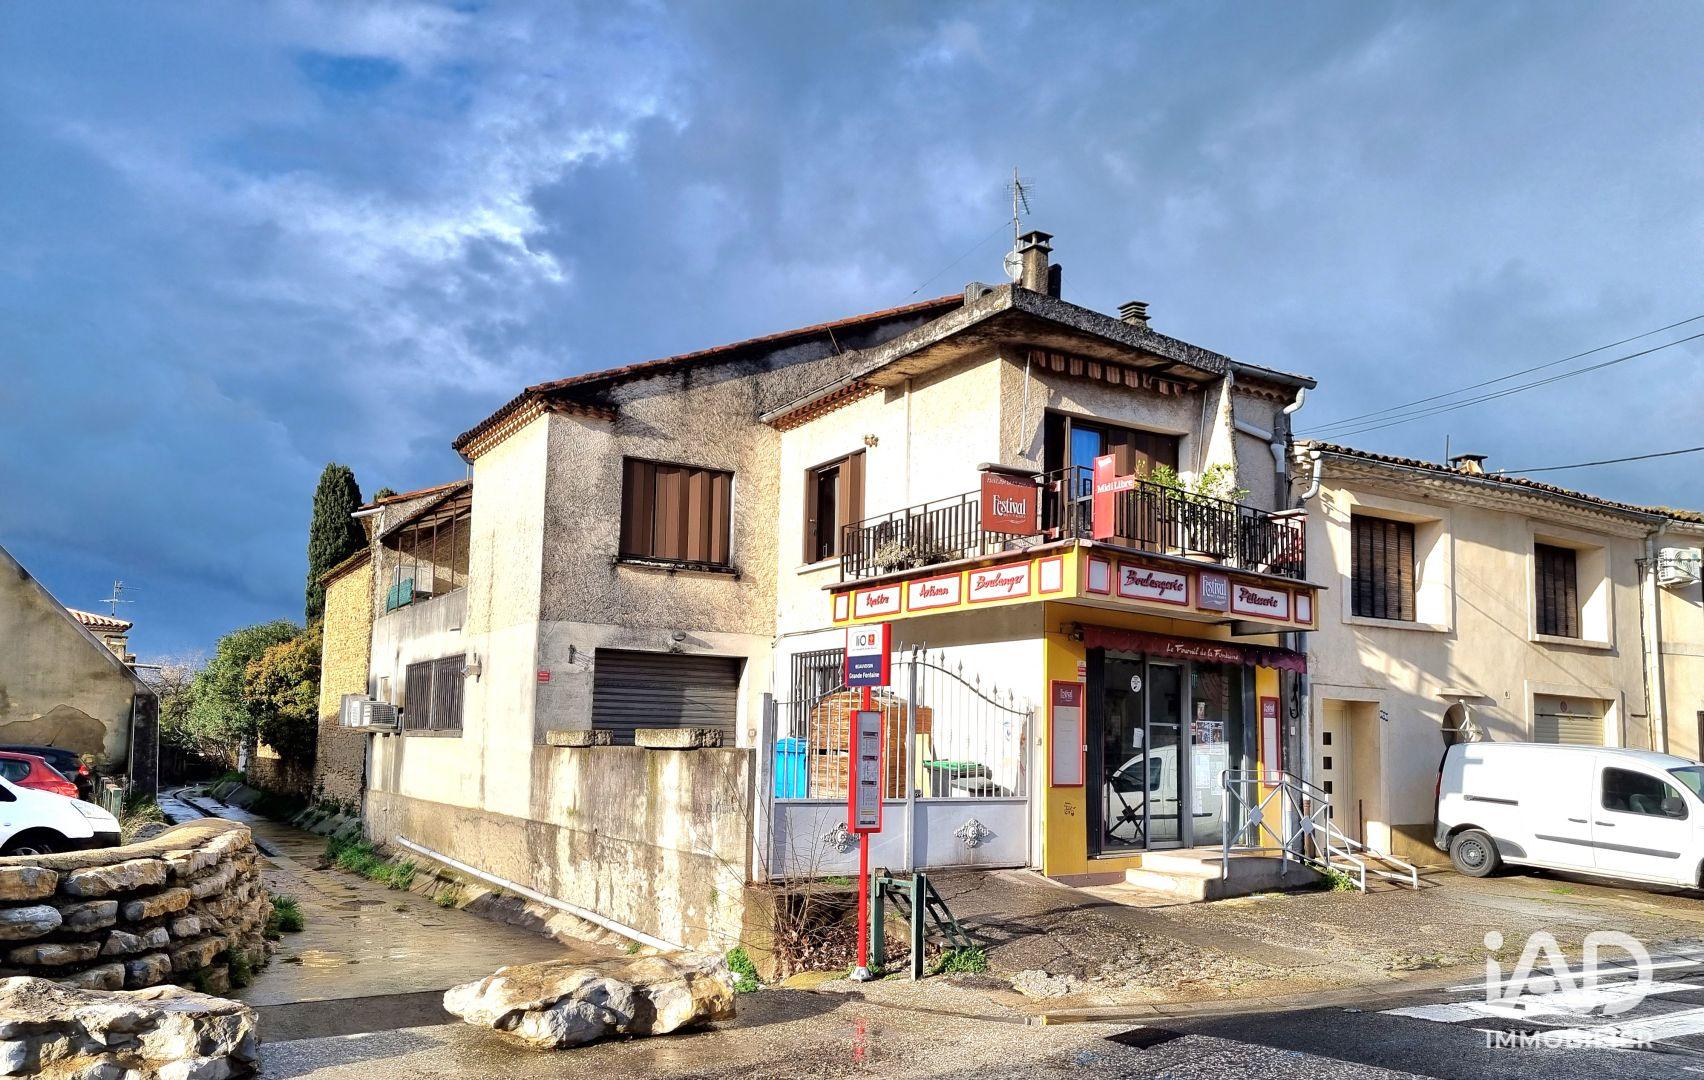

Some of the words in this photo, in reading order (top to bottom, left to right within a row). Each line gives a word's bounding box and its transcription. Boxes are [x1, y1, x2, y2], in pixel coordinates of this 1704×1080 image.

[1097, 481, 1113, 494] Midi
[1113, 479, 1133, 491] Libre
[992, 494, 1026, 516] Festival
[919, 584, 949, 598] Artisan
[974, 573, 1025, 592] Boulanger
[1124, 569, 1184, 596] Boulangerie
[1202, 575, 1227, 597] Festival
[1166, 643, 1174, 653] Le
[1175, 644, 1199, 655] Fournil
[1199, 649, 1206, 657] de
[1207, 648, 1213, 657] la
